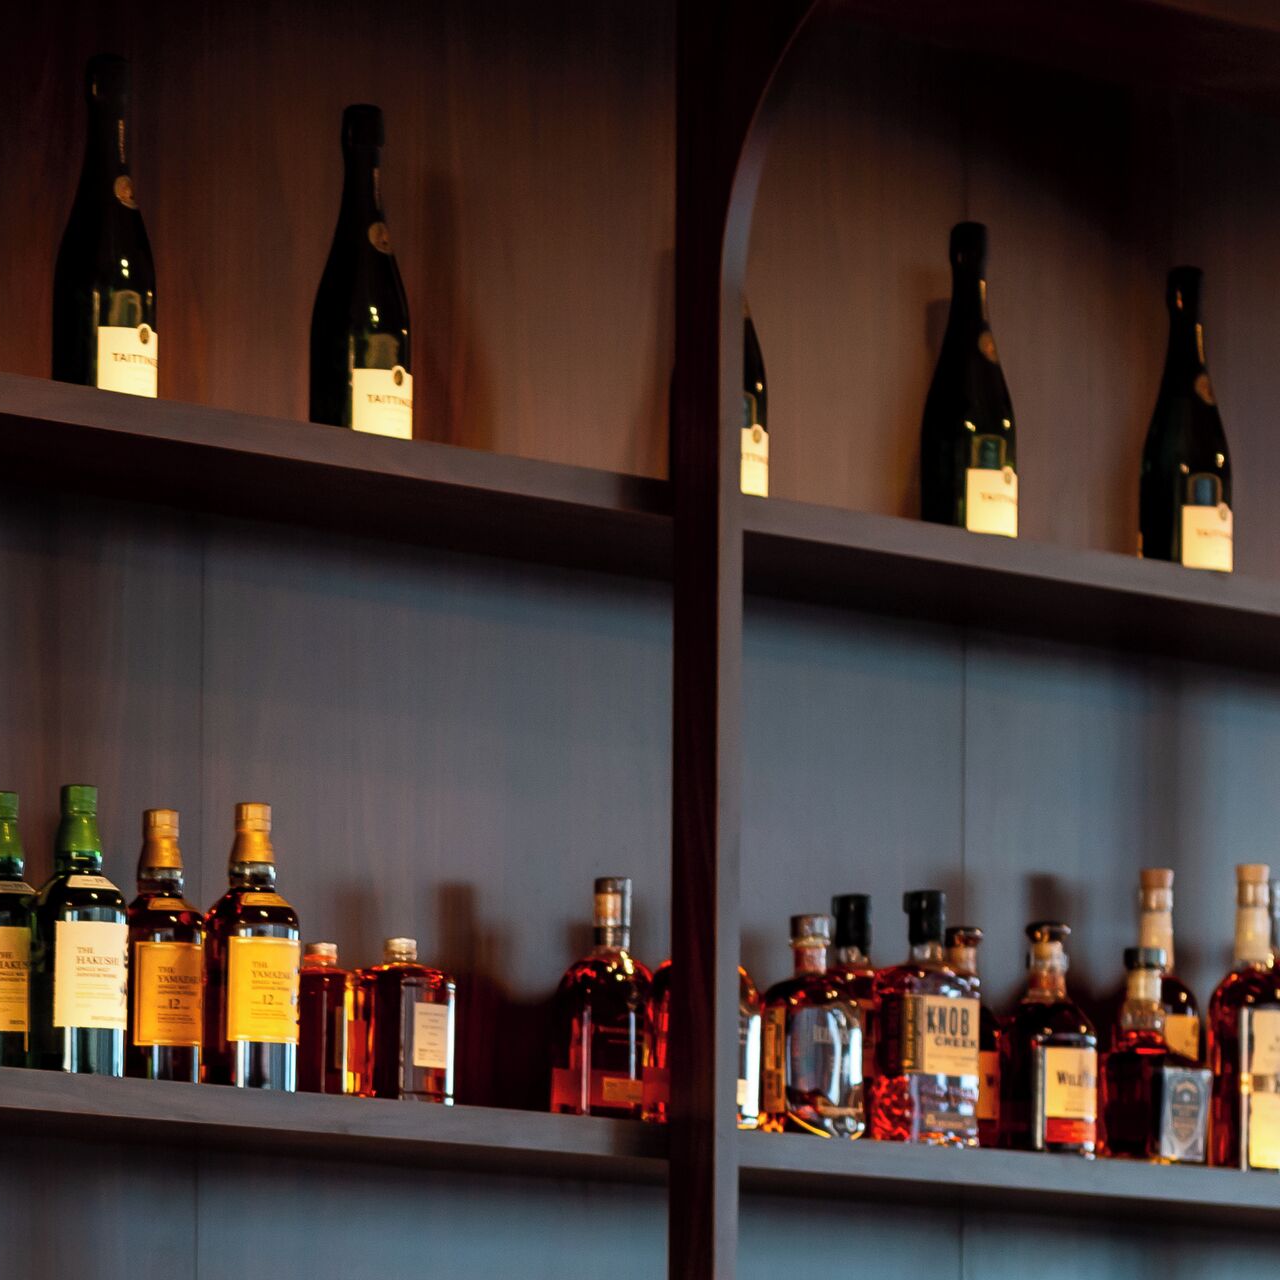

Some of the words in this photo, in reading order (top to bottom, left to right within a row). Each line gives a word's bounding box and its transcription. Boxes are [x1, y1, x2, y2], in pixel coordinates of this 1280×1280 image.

[76, 946, 94, 955] THE
[158, 966, 176, 974] THE
[252, 960, 269, 969] THE
[168, 998, 182, 1010] 12
[261, 994, 275, 1006] 12
[926, 1004, 970, 1036] KNOB
[934, 1036, 977, 1050] CREEK
